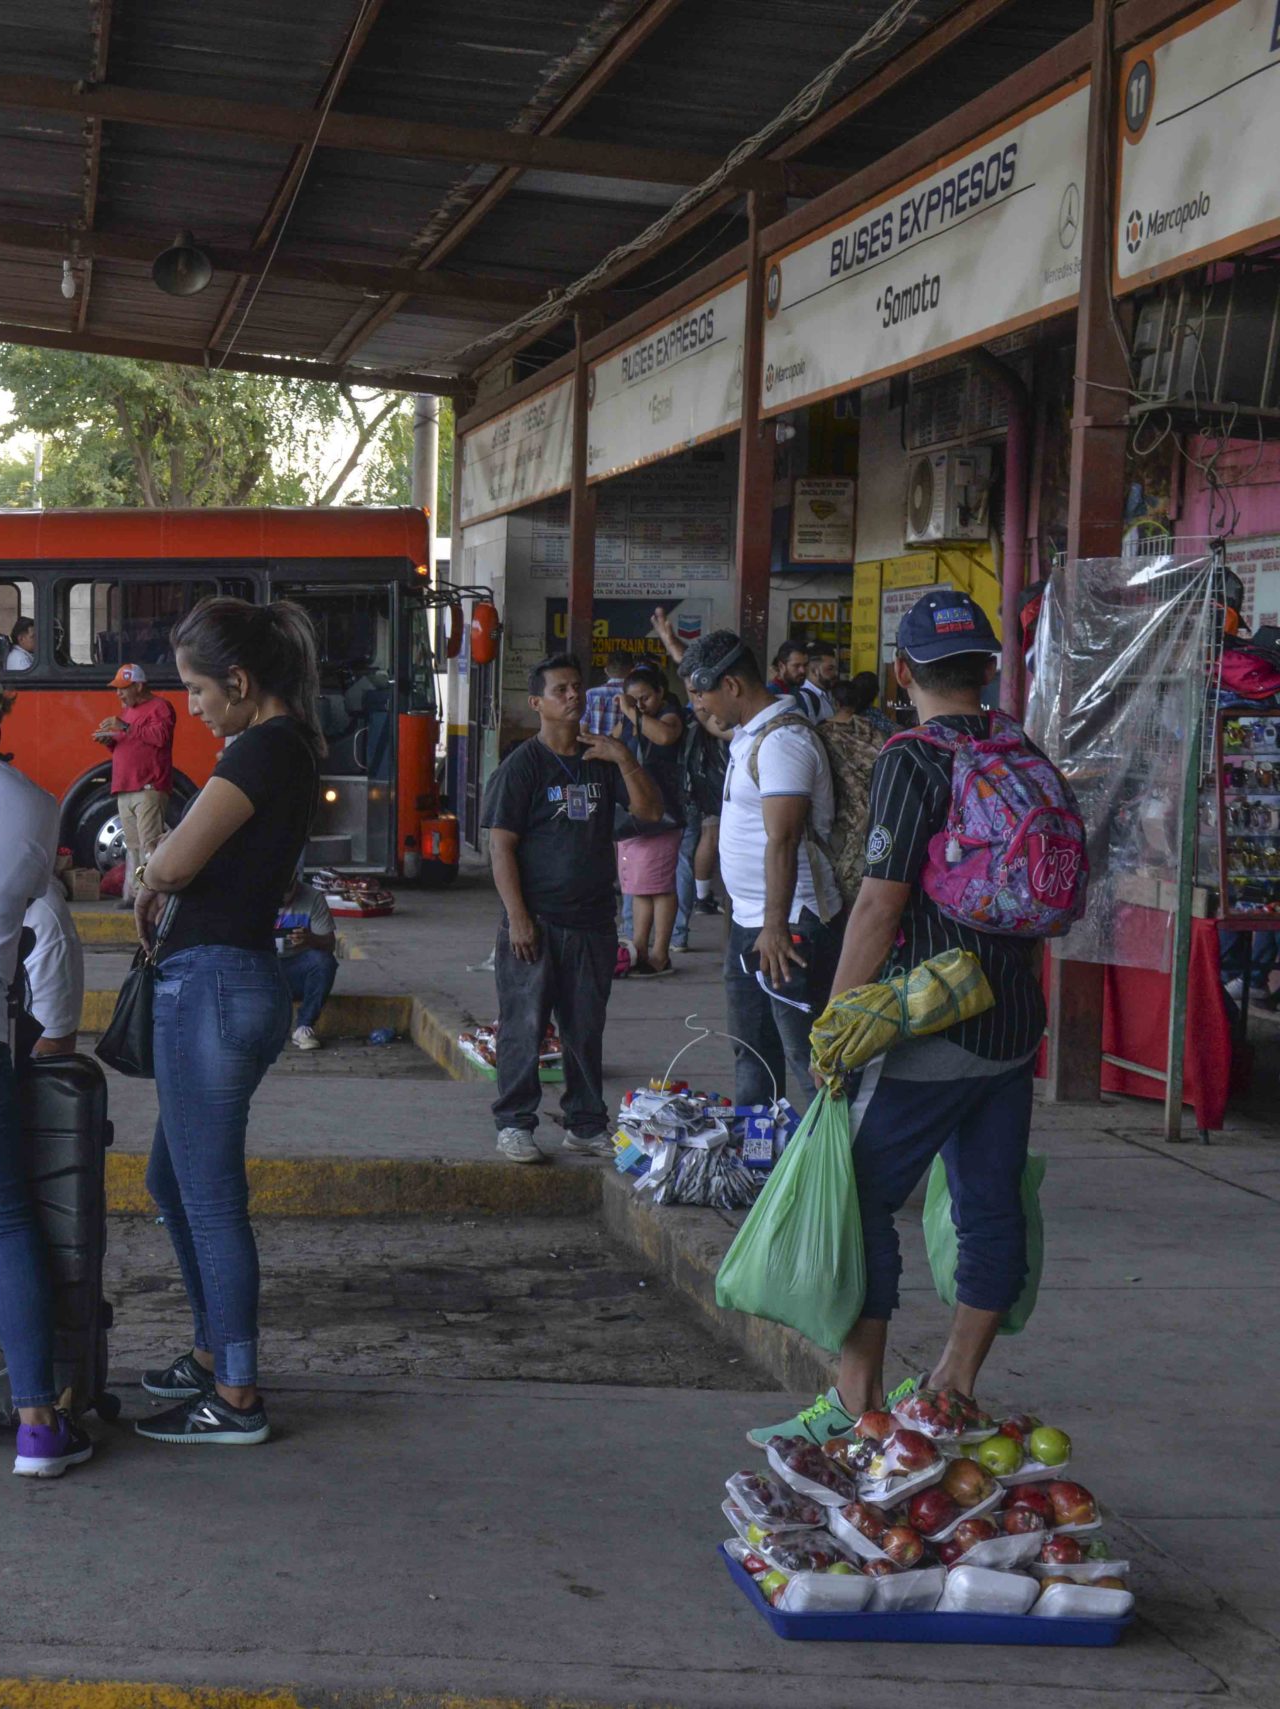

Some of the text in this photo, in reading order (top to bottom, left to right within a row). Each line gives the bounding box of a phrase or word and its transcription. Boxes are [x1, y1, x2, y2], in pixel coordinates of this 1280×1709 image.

[1130, 74, 1148, 118] 11
[830, 143, 1017, 277] BUSES EXPRESOS
[1146, 191, 1210, 239] Marcopolo
[882, 273, 941, 329] Somoto
[622, 308, 714, 384] BUSES EXPRESOS
[774, 358, 806, 384] Marcopolo
